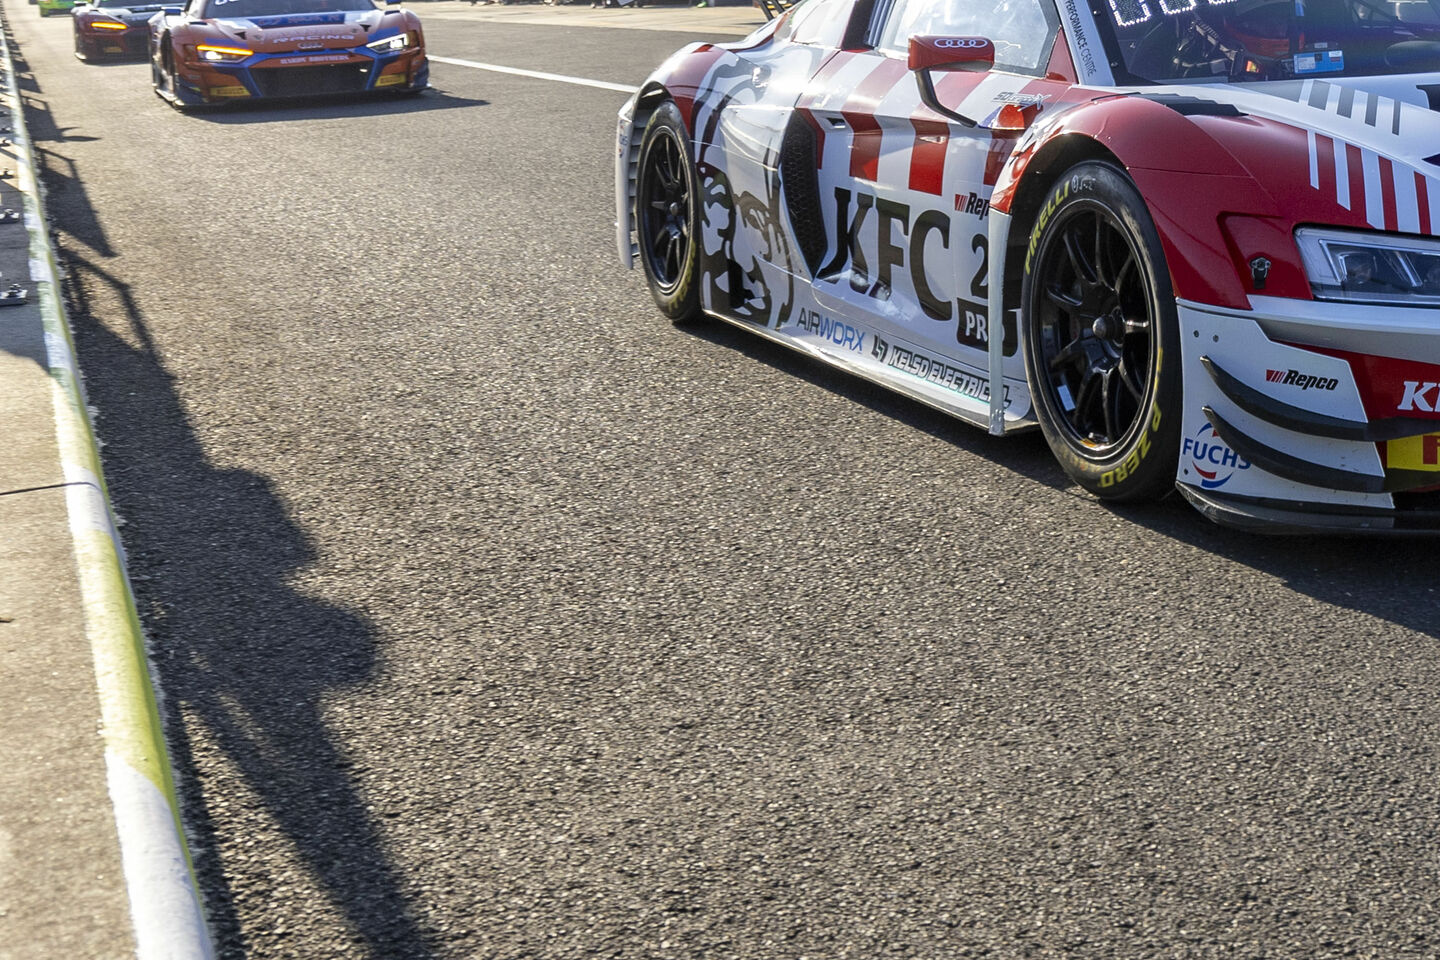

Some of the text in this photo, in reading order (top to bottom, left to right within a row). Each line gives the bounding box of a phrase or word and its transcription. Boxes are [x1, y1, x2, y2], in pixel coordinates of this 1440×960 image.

[1065, 0, 1088, 49] PERFORMANCE
[1081, 48, 1097, 77] CENTRE
[965, 192, 990, 221] Rep
[1025, 181, 1070, 275] PIRELLI
[815, 186, 952, 321] KFC
[797, 307, 865, 352] AIRWORX
[964, 310, 1006, 342] PR
[888, 345, 1013, 409] KELSO ELECTRICL
[1283, 369, 1339, 390] Repco
[1101, 439, 1152, 488] ZERO
